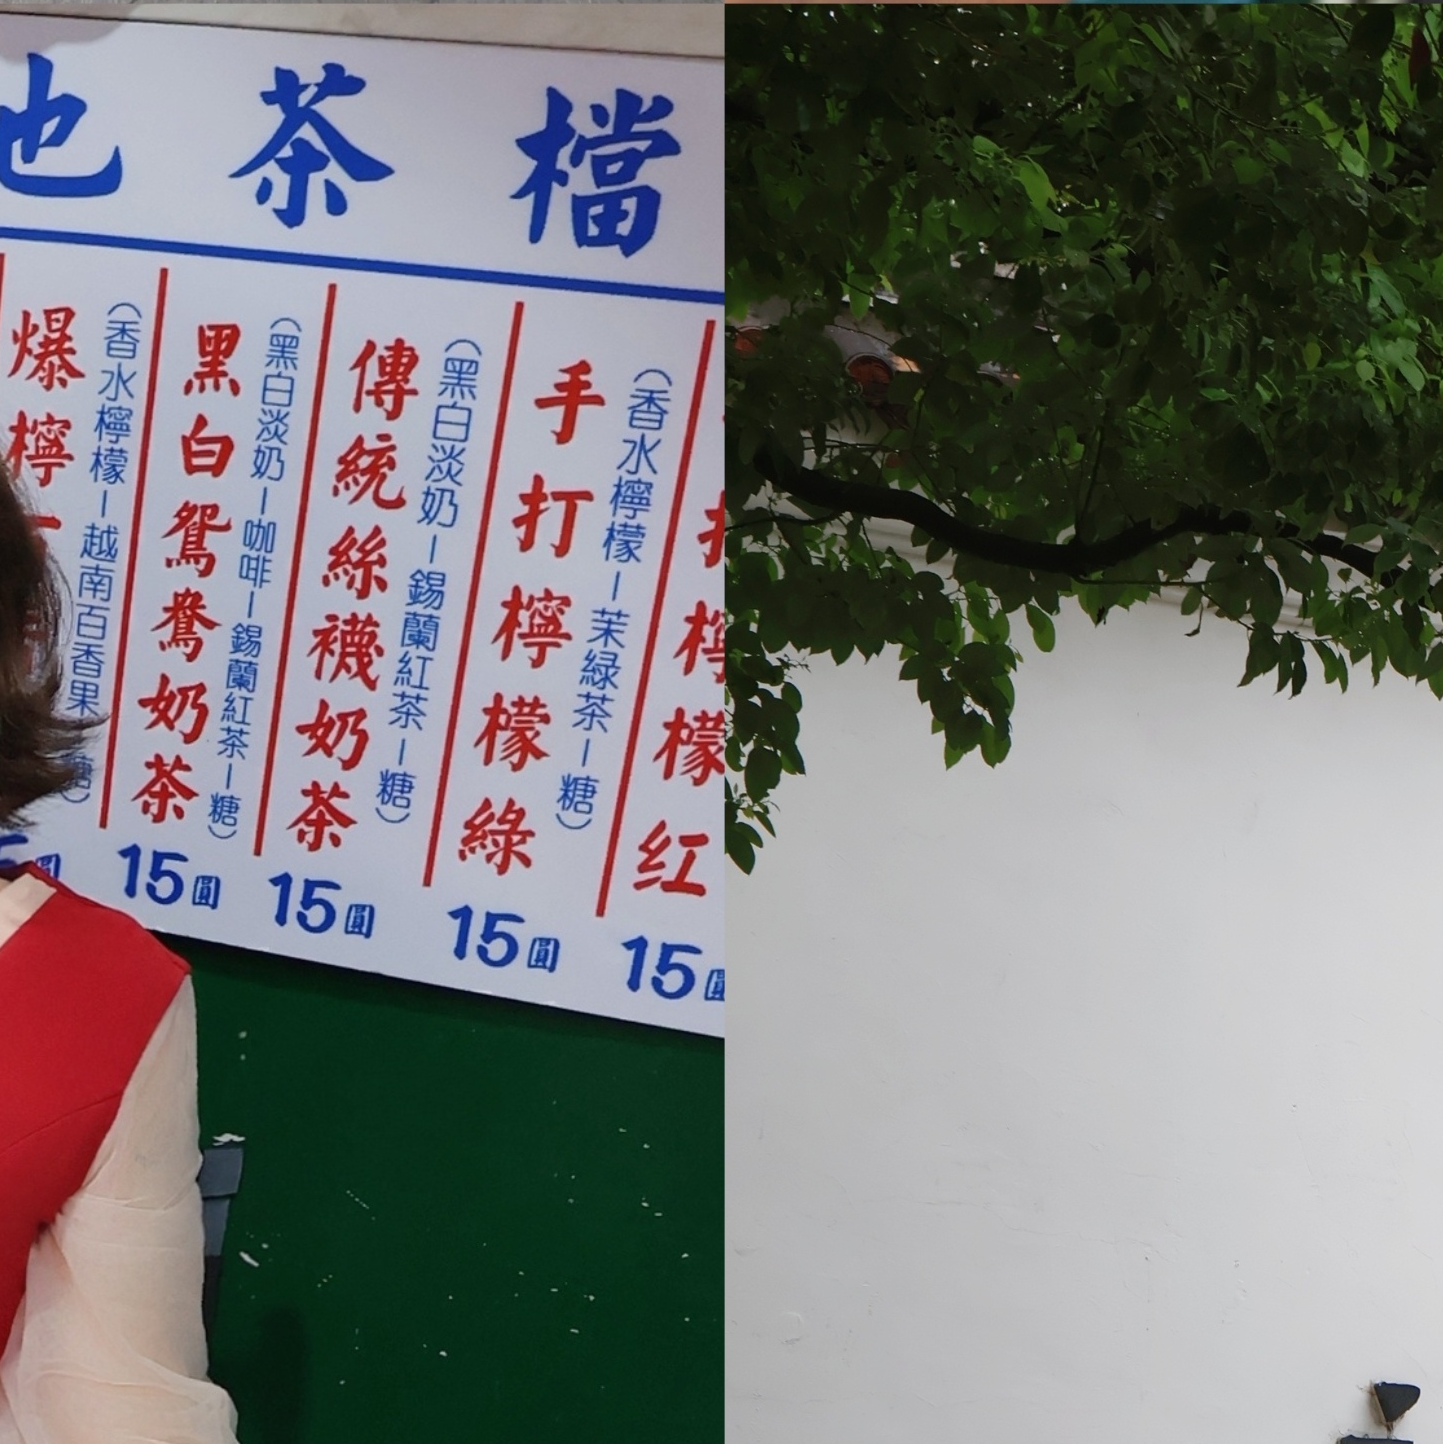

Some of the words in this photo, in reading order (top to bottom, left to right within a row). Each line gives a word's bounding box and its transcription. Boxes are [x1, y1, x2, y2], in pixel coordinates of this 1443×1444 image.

[130, 322, 241, 824] 黑白鴛鴦奶茶
[287, 337, 420, 852] 傳統絲襪奶茶
[117, 843, 221, 911] 15圓
[268, 871, 375, 940] 15圓
[447, 904, 560, 973] 15圓
